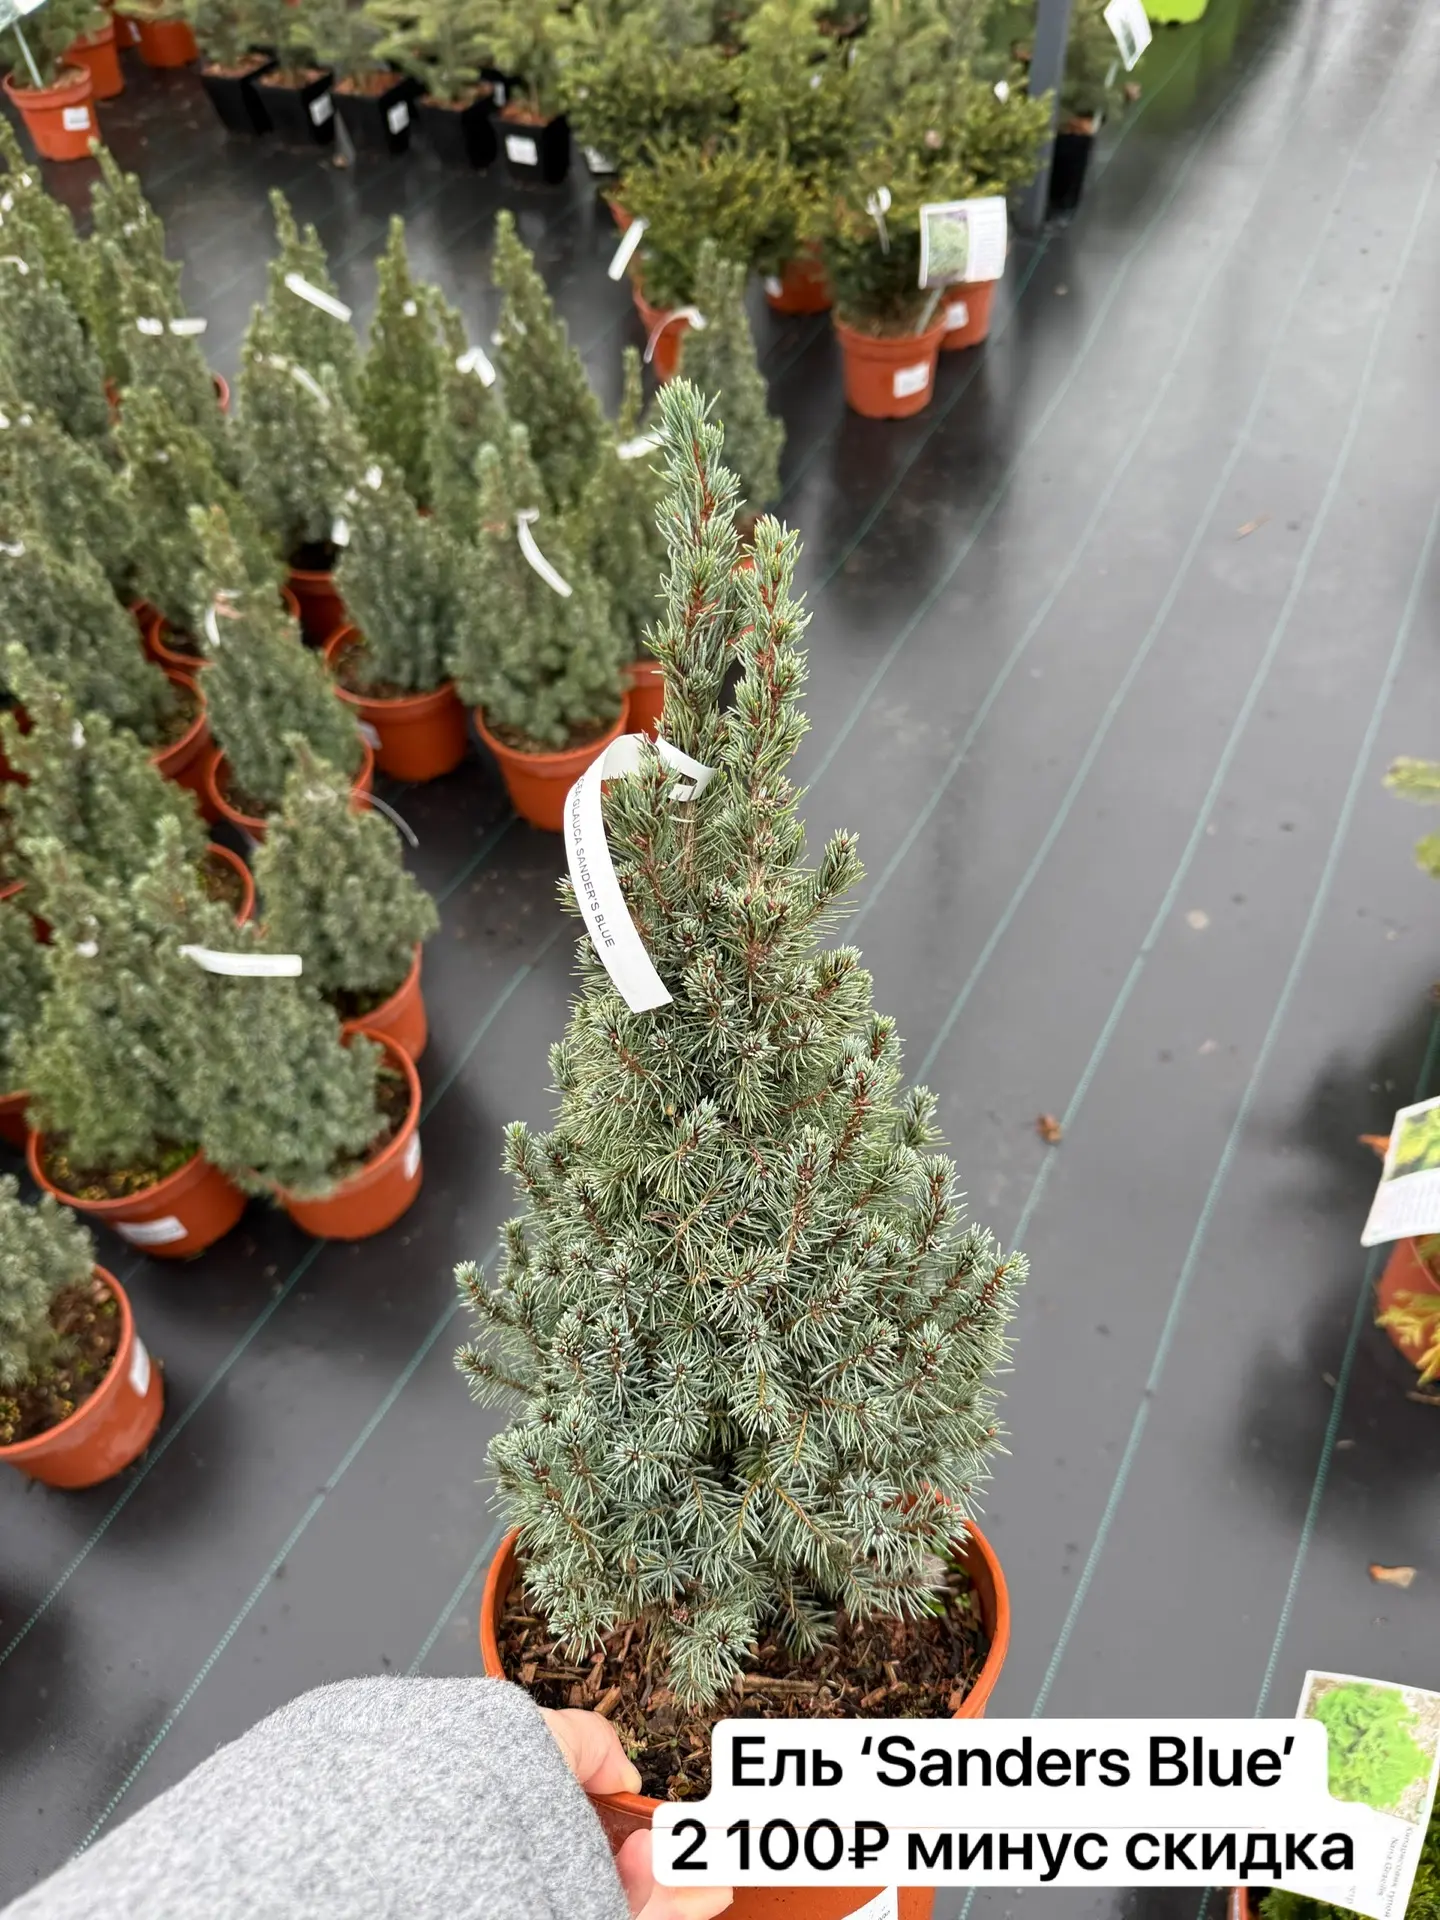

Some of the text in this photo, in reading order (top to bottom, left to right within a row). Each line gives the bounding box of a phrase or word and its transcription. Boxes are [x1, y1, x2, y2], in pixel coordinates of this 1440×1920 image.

[572, 798, 582, 846] GLAUCA
[576, 848, 600, 911] SANDER'S
[594, 913, 616, 948] BLUE
